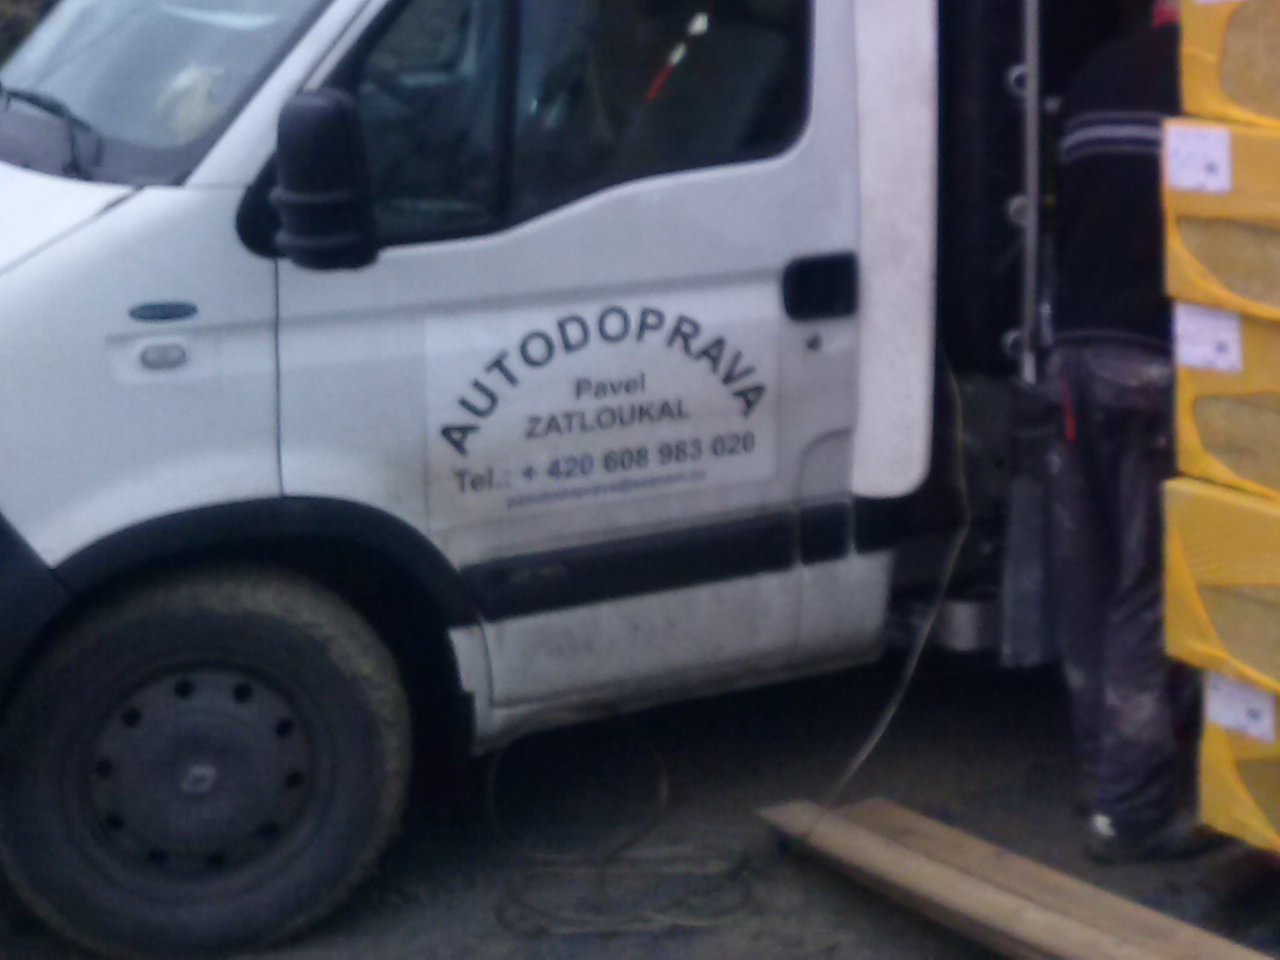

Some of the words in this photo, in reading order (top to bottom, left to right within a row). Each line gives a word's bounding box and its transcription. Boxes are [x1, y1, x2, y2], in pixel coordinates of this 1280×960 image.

[440, 306, 767, 457] AUTODOPRAVA
[574, 373, 646, 400] Pavel
[525, 400, 690, 439] ZATLOUKAL
[547, 453, 595, 480] 420
[603, 446, 649, 474] 608
